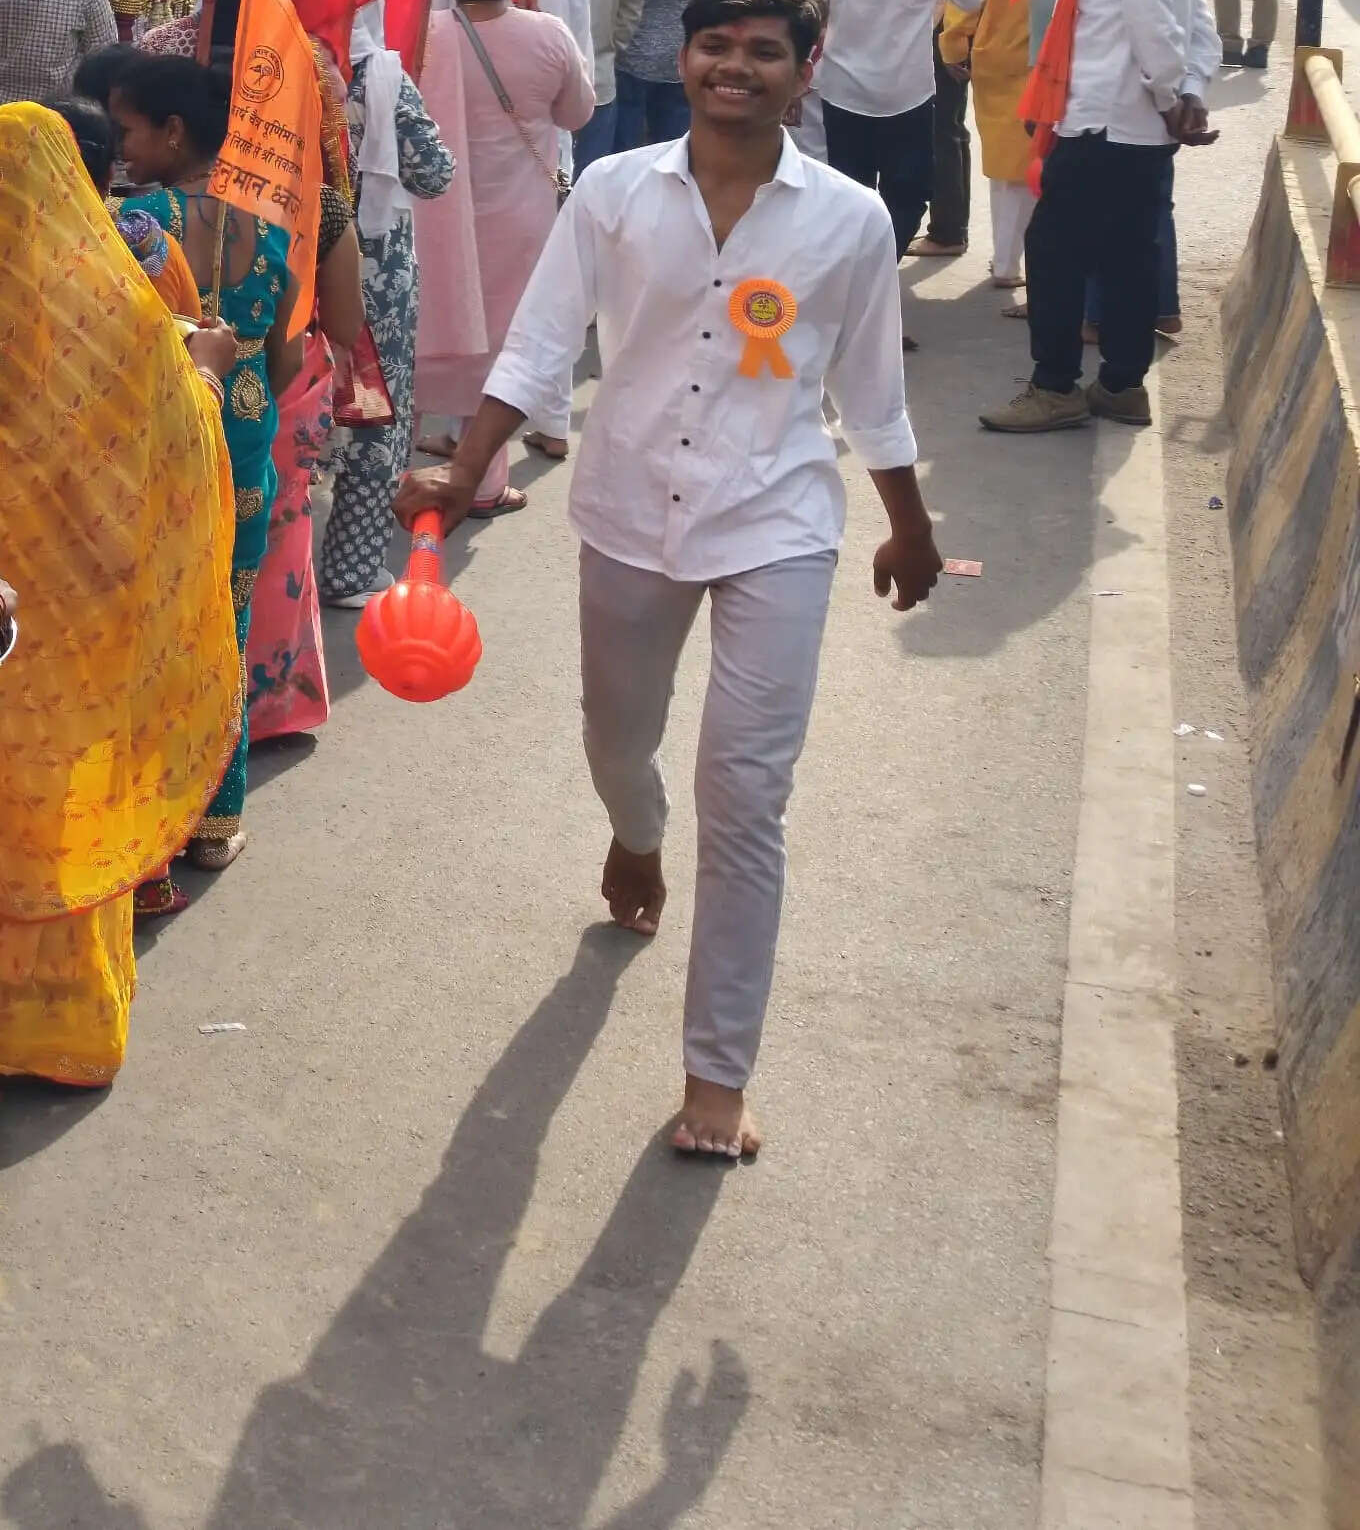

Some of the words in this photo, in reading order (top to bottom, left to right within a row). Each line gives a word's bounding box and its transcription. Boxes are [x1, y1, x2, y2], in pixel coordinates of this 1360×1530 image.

[249, 109, 264, 130] चैत्र
[263, 119, 297, 145] पूर्णिमा
[253, 142, 263, 159] से
[261, 147, 276, 164] श्री
